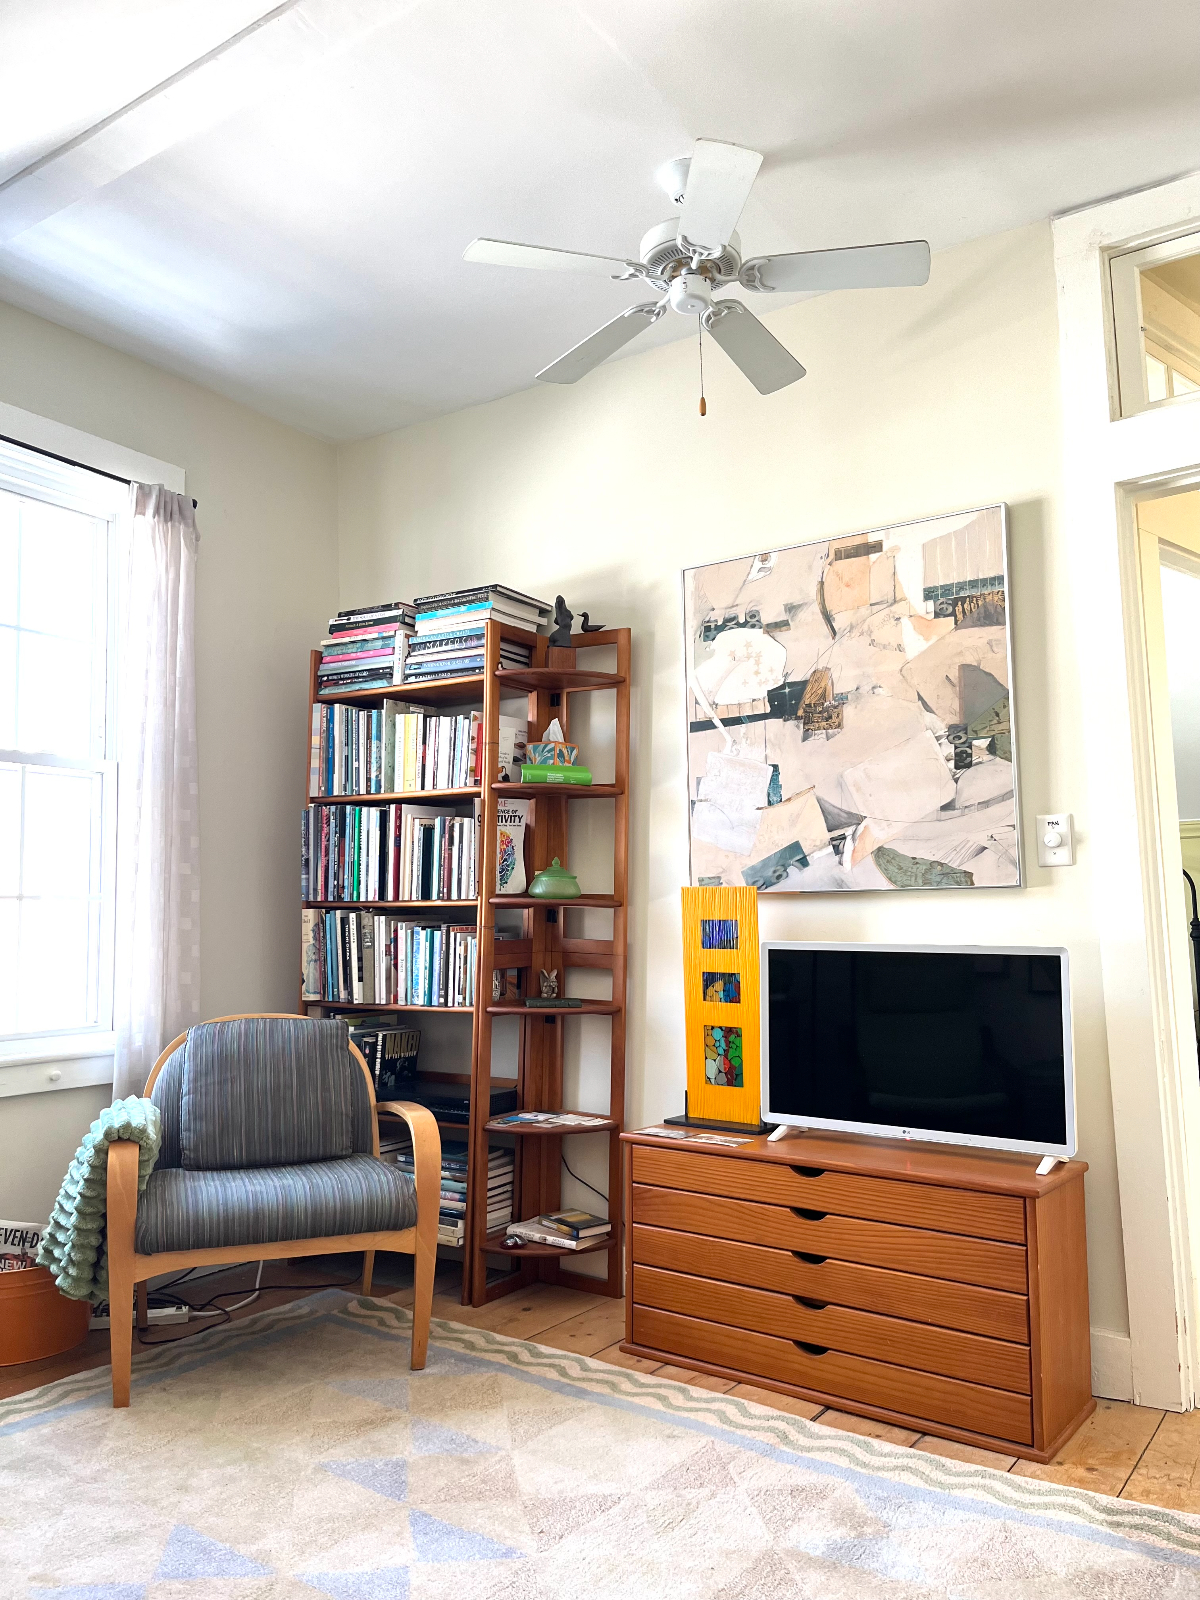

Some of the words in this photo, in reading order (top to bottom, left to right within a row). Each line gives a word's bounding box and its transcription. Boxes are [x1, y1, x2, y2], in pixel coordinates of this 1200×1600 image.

[426, 637, 466, 650] MAKERS
[385, 1033, 420, 1056] NAKED
[0, 1227, 28, 1247] VEN
